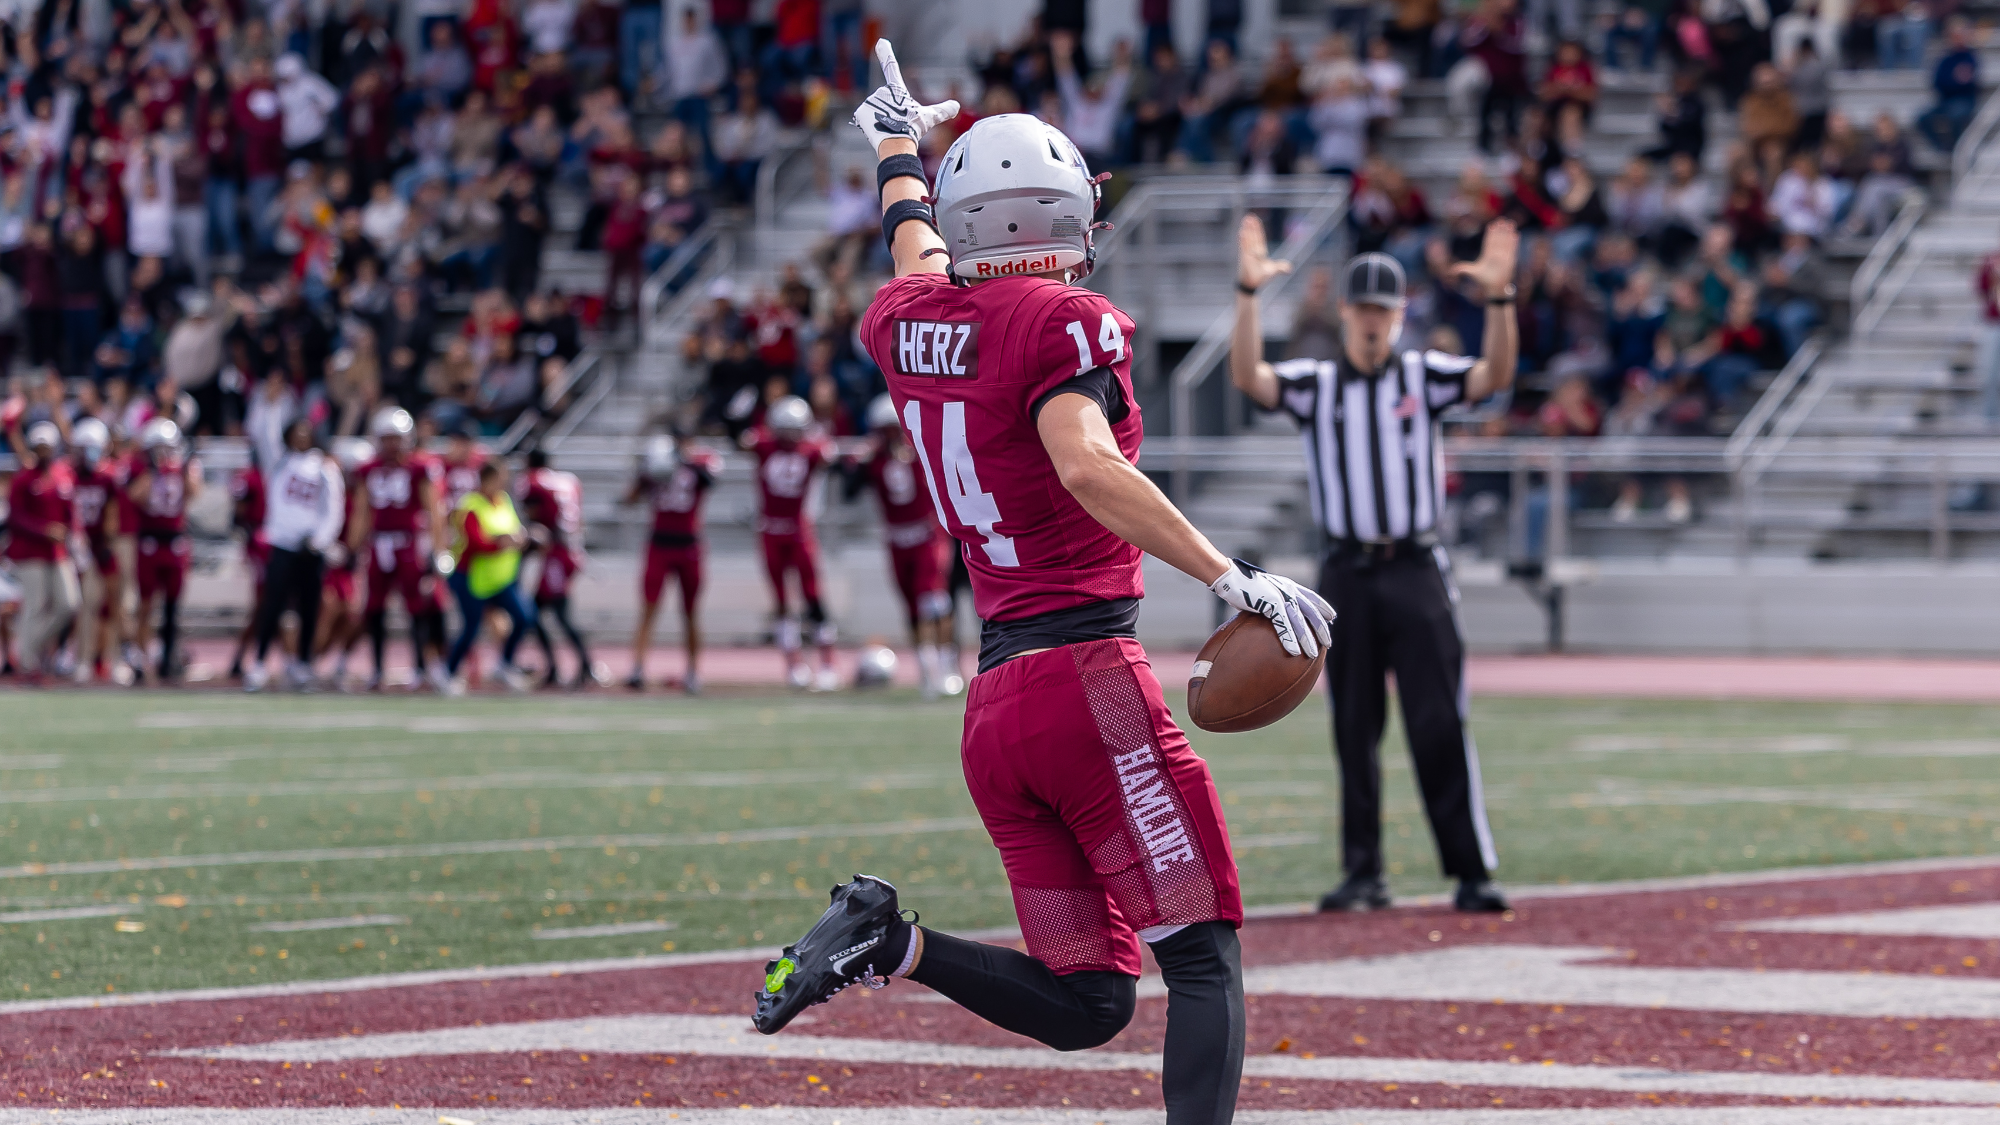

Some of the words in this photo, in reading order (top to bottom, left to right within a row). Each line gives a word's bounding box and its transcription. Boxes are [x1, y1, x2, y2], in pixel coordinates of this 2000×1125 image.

[976, 254, 1058, 278] Riddell
[899, 321, 971, 376] HERZ
[1065, 312, 1126, 377] 14
[903, 400, 1020, 568] 14
[1114, 743, 1195, 873] HAMLINE
[828, 948, 851, 962] ZOOM
[850, 935, 880, 953] AIR
